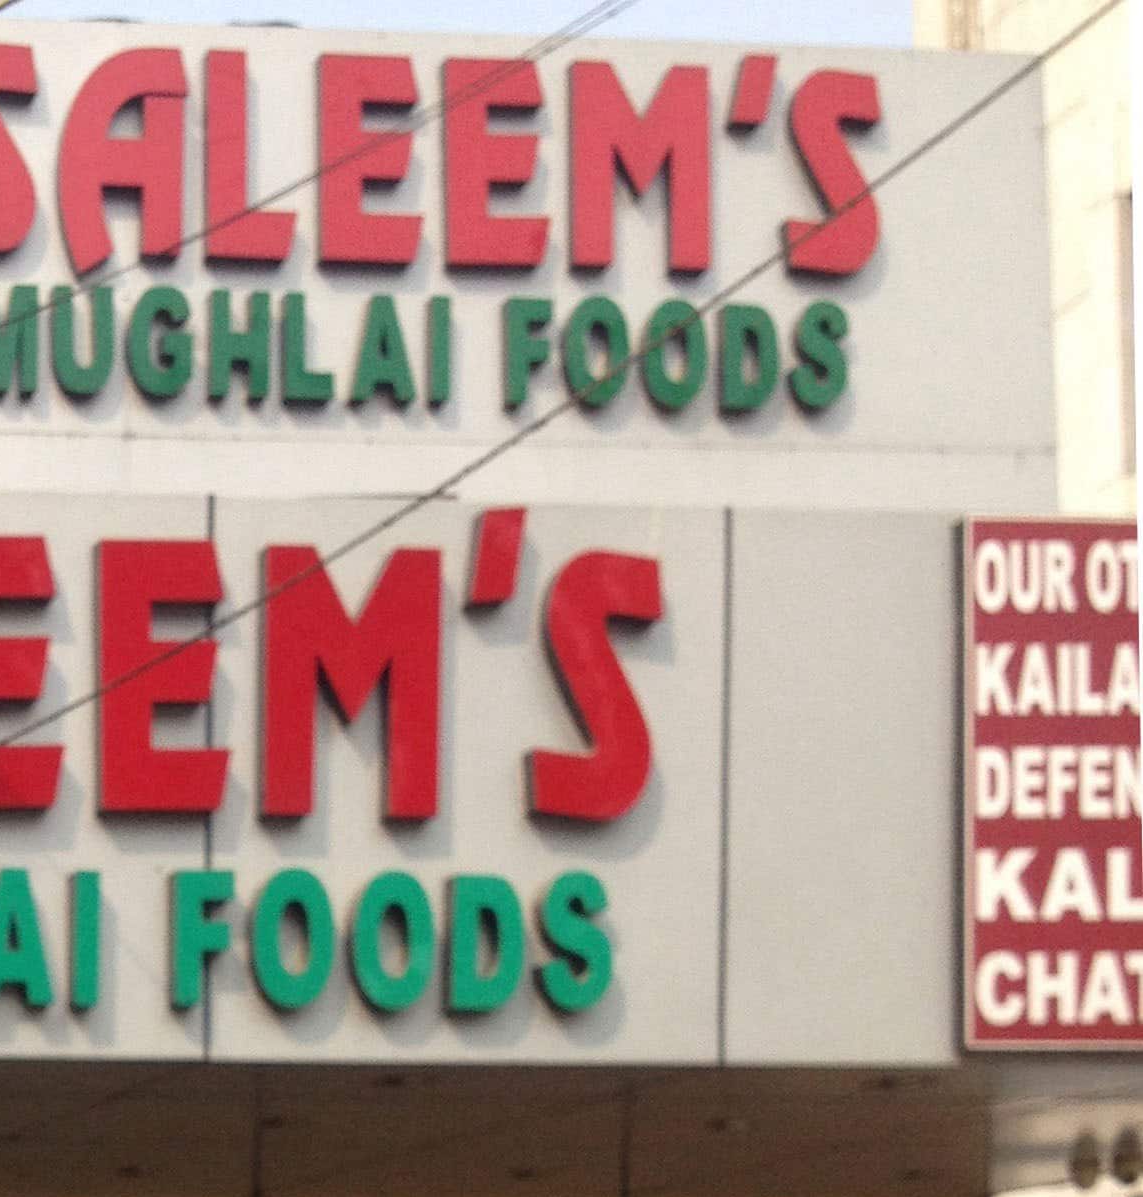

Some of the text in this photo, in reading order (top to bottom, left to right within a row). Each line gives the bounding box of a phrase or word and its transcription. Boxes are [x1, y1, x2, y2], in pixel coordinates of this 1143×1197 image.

[502, 296, 851, 417] FOODS
[974, 540, 1078, 613] OUR
[975, 642, 1141, 717] KAILA
[975, 848, 1143, 922] KAL
[168, 869, 614, 1020] FOODS
